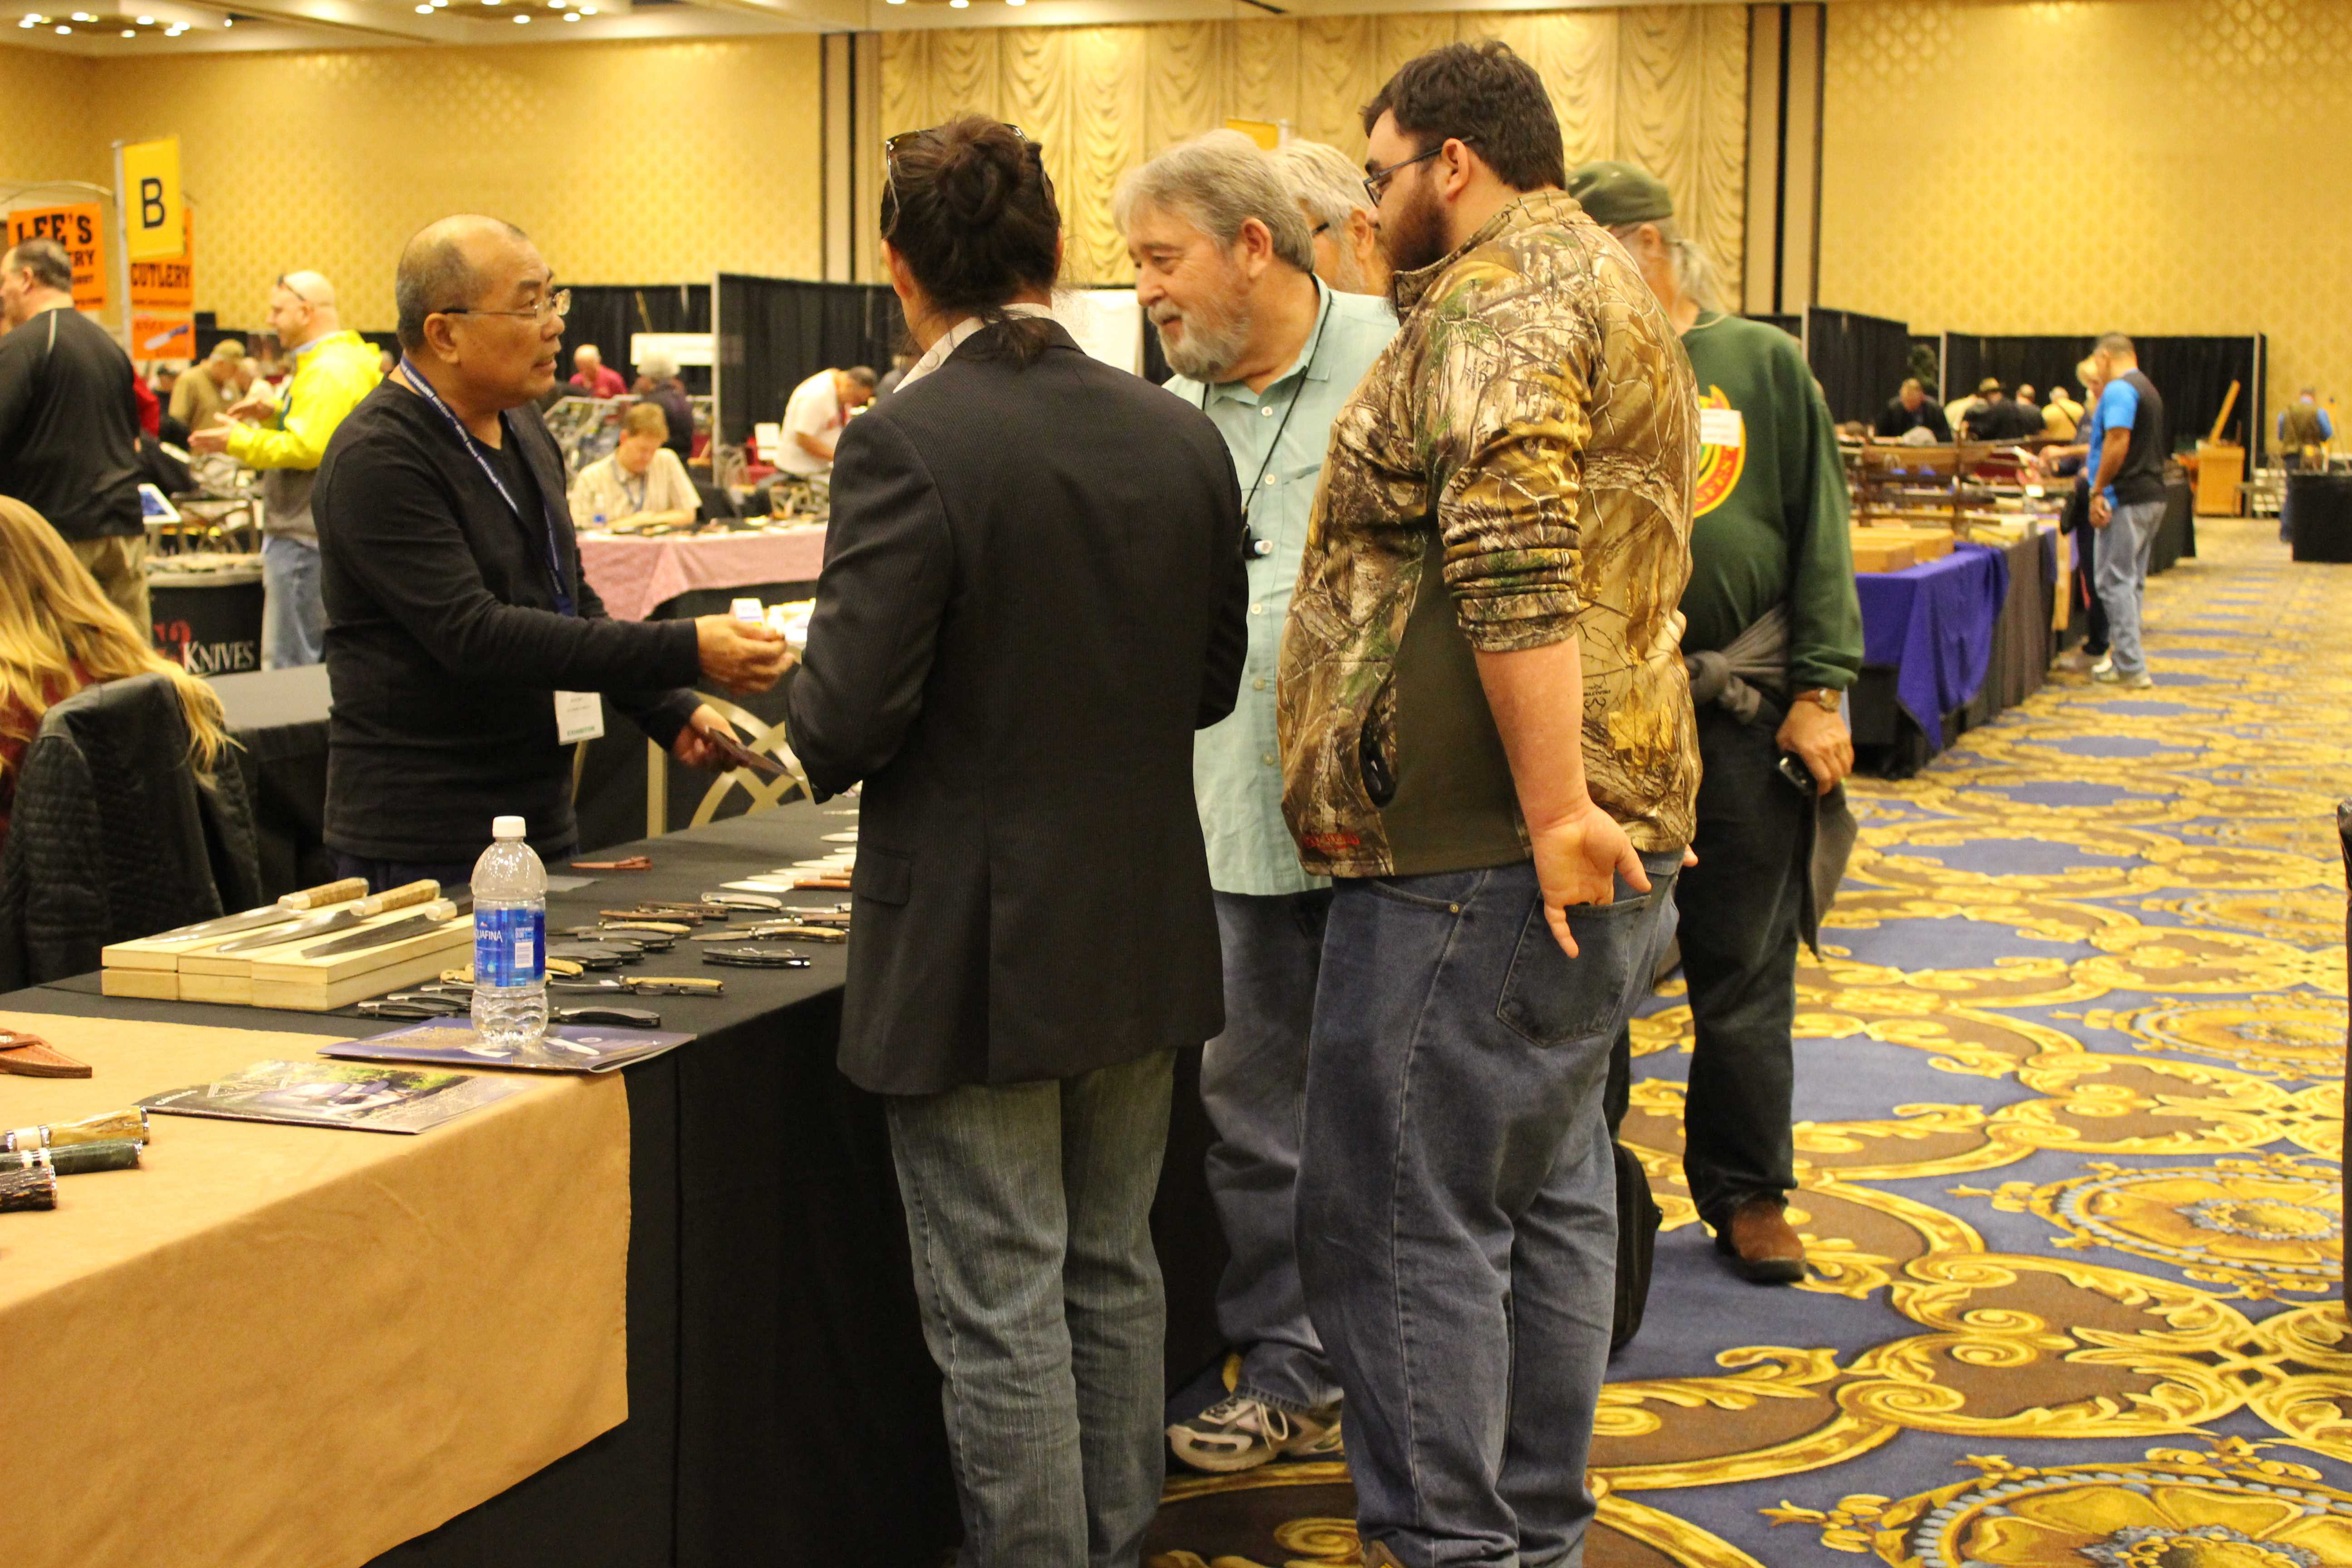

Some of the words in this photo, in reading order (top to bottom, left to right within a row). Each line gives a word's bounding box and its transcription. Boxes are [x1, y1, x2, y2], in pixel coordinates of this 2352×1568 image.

[141, 177, 165, 228] B
[130, 262, 190, 288] CUTLERY
[183, 639, 255, 674] KNIVES
